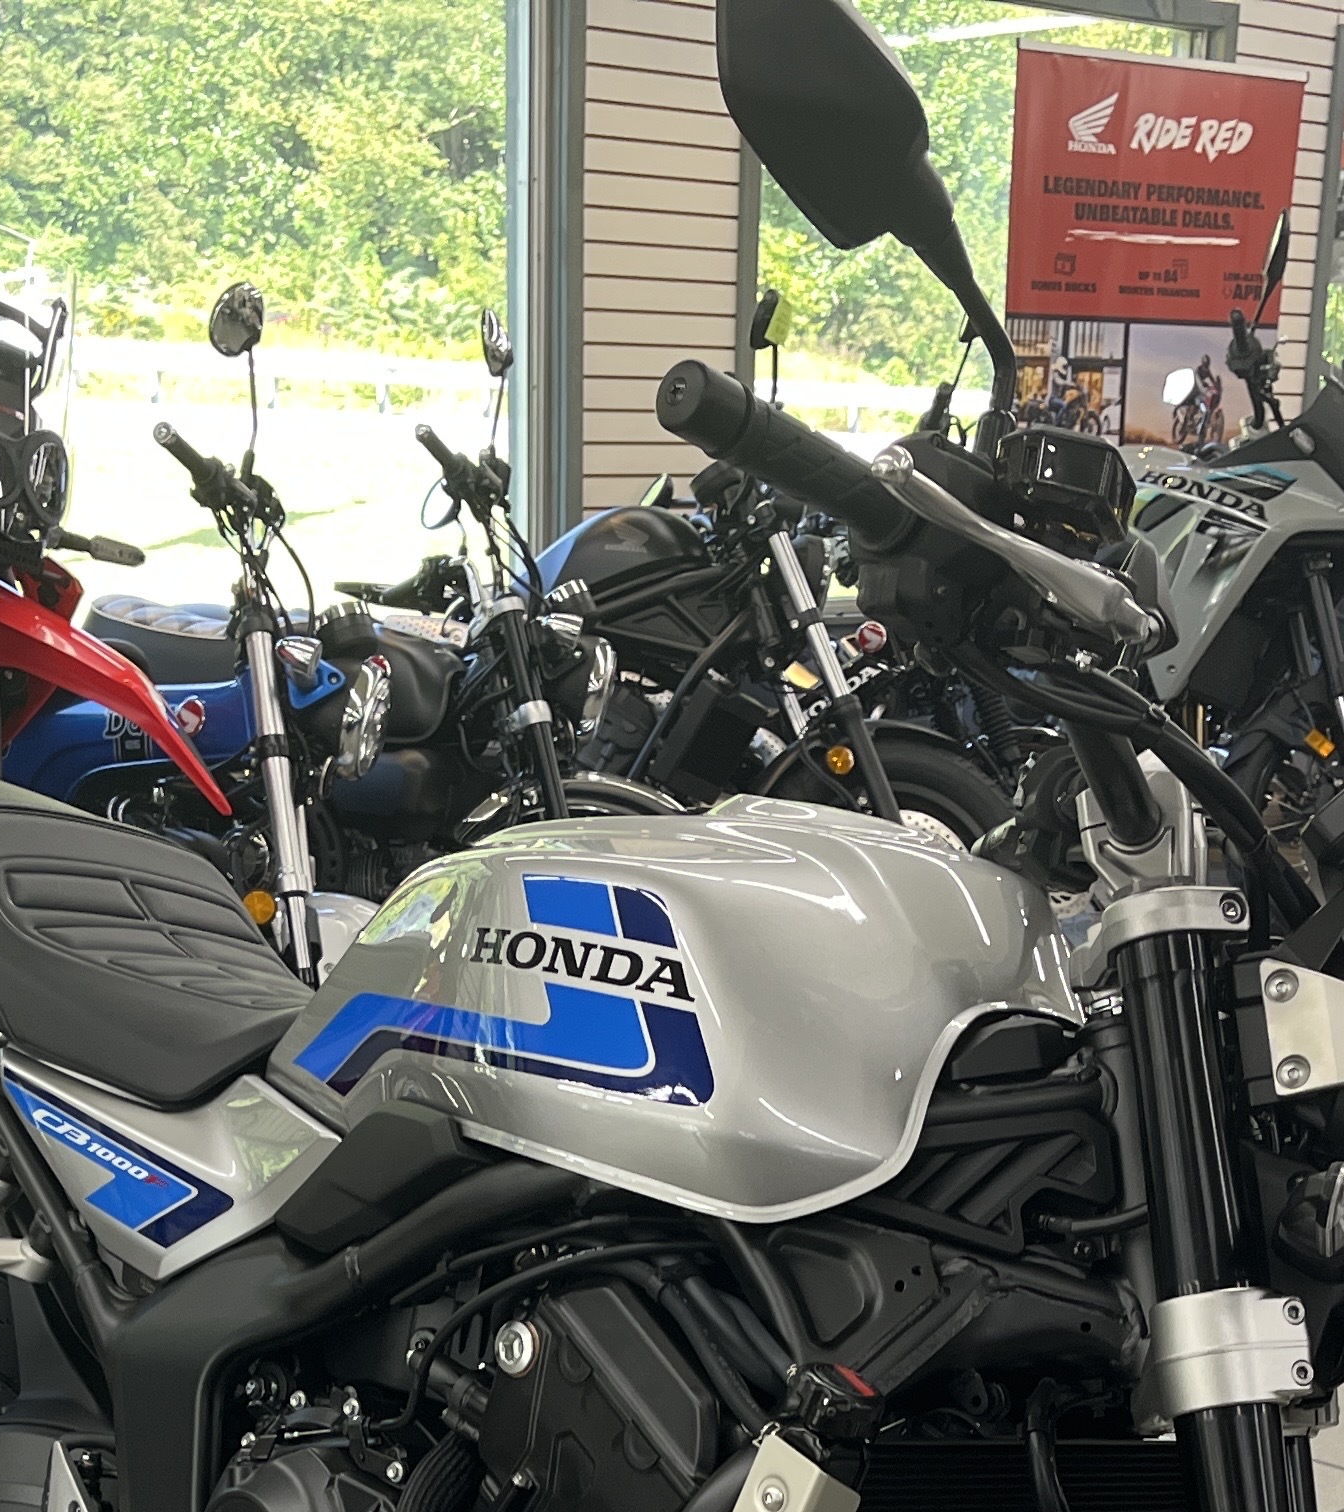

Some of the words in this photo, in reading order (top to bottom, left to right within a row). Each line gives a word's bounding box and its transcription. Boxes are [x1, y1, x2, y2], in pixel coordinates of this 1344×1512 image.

[1067, 140, 1116, 155] HONDA
[1130, 112, 1198, 155] RIDE
[1194, 118, 1254, 163] RED
[1043, 175, 1142, 201] LEGENDARY
[1146, 182, 1265, 210] PERFORMANCE.
[1074, 202, 1178, 227] UNBEATABLE
[1181, 211, 1235, 231] DEALS.
[1135, 470, 1268, 522] HONDA
[469, 927, 696, 1003] HONDA
